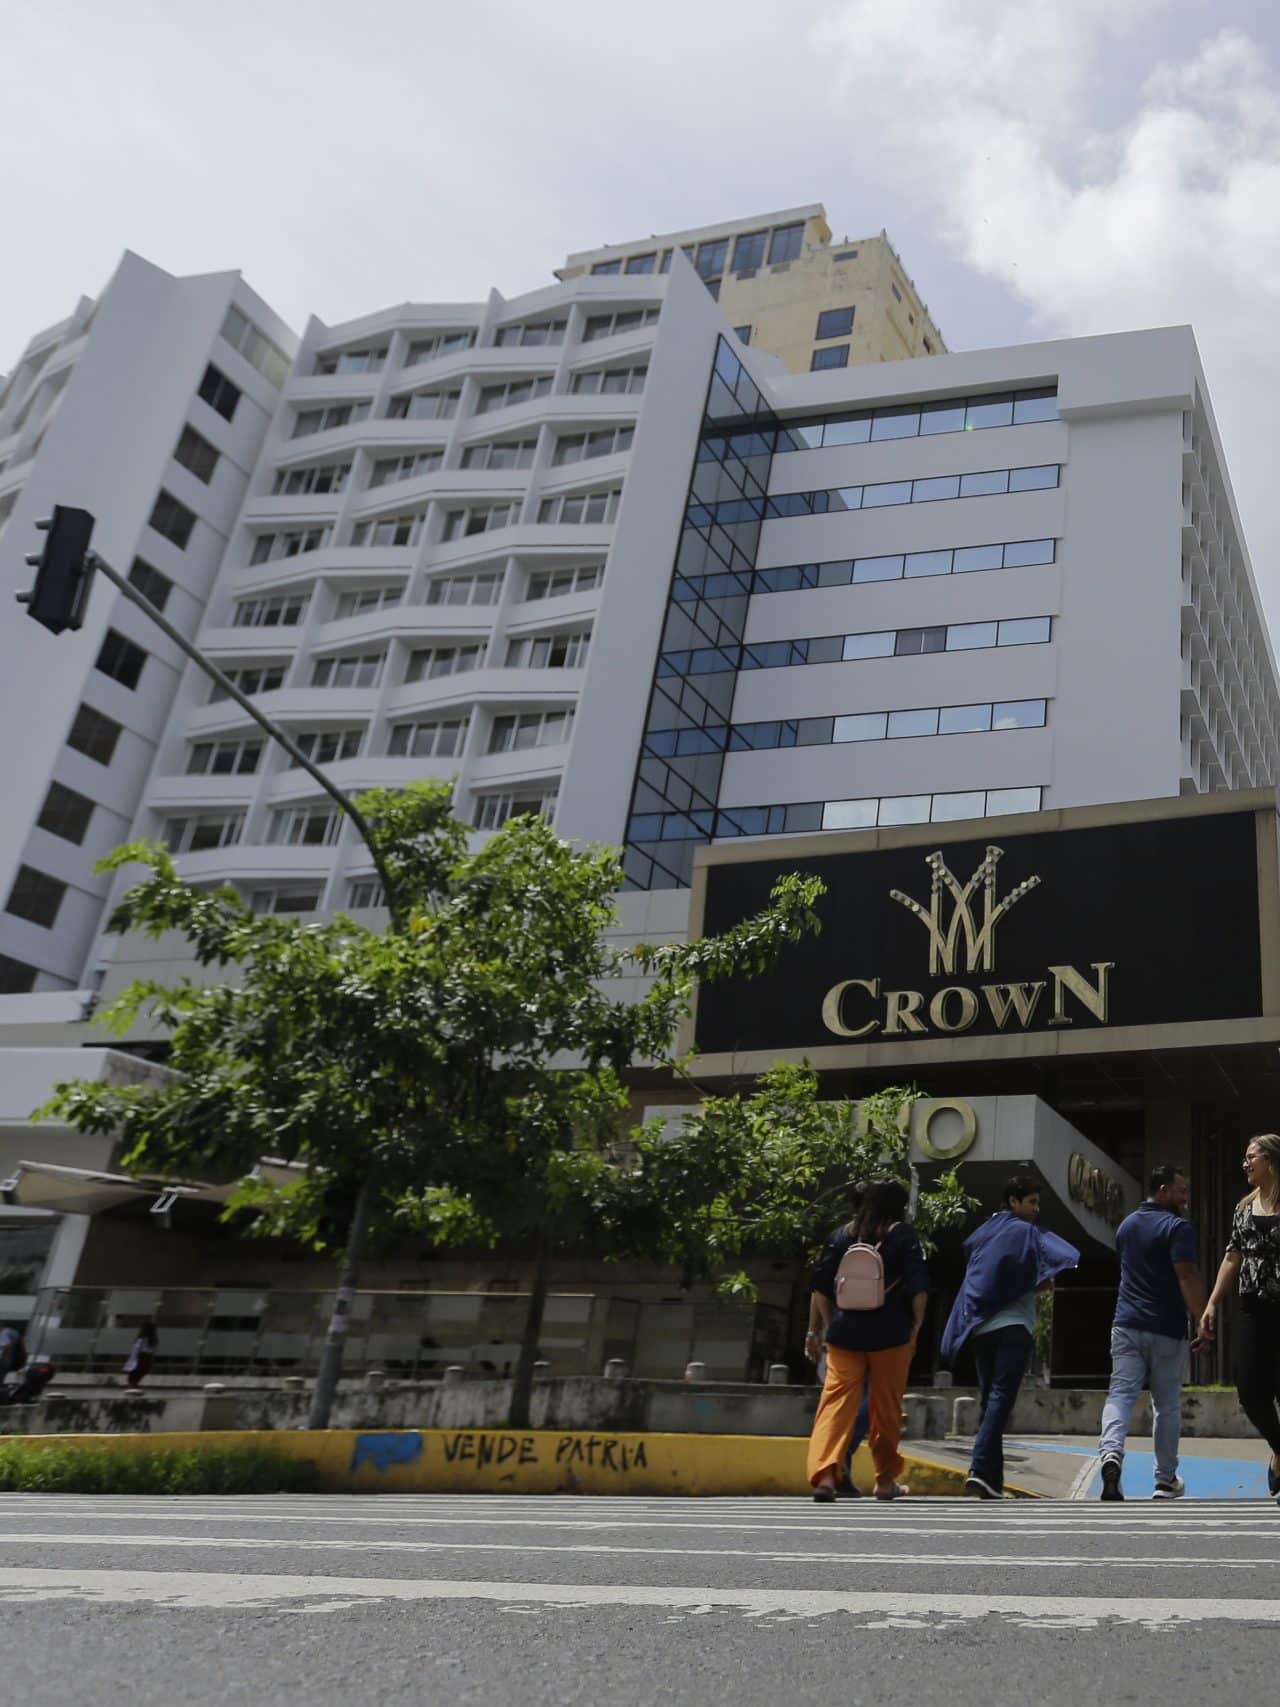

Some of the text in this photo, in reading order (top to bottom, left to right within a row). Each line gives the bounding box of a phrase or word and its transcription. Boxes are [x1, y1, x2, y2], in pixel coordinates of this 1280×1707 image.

[821, 962, 1116, 1037] CROWN
[442, 1433, 649, 1473] VENDE PATRIA
